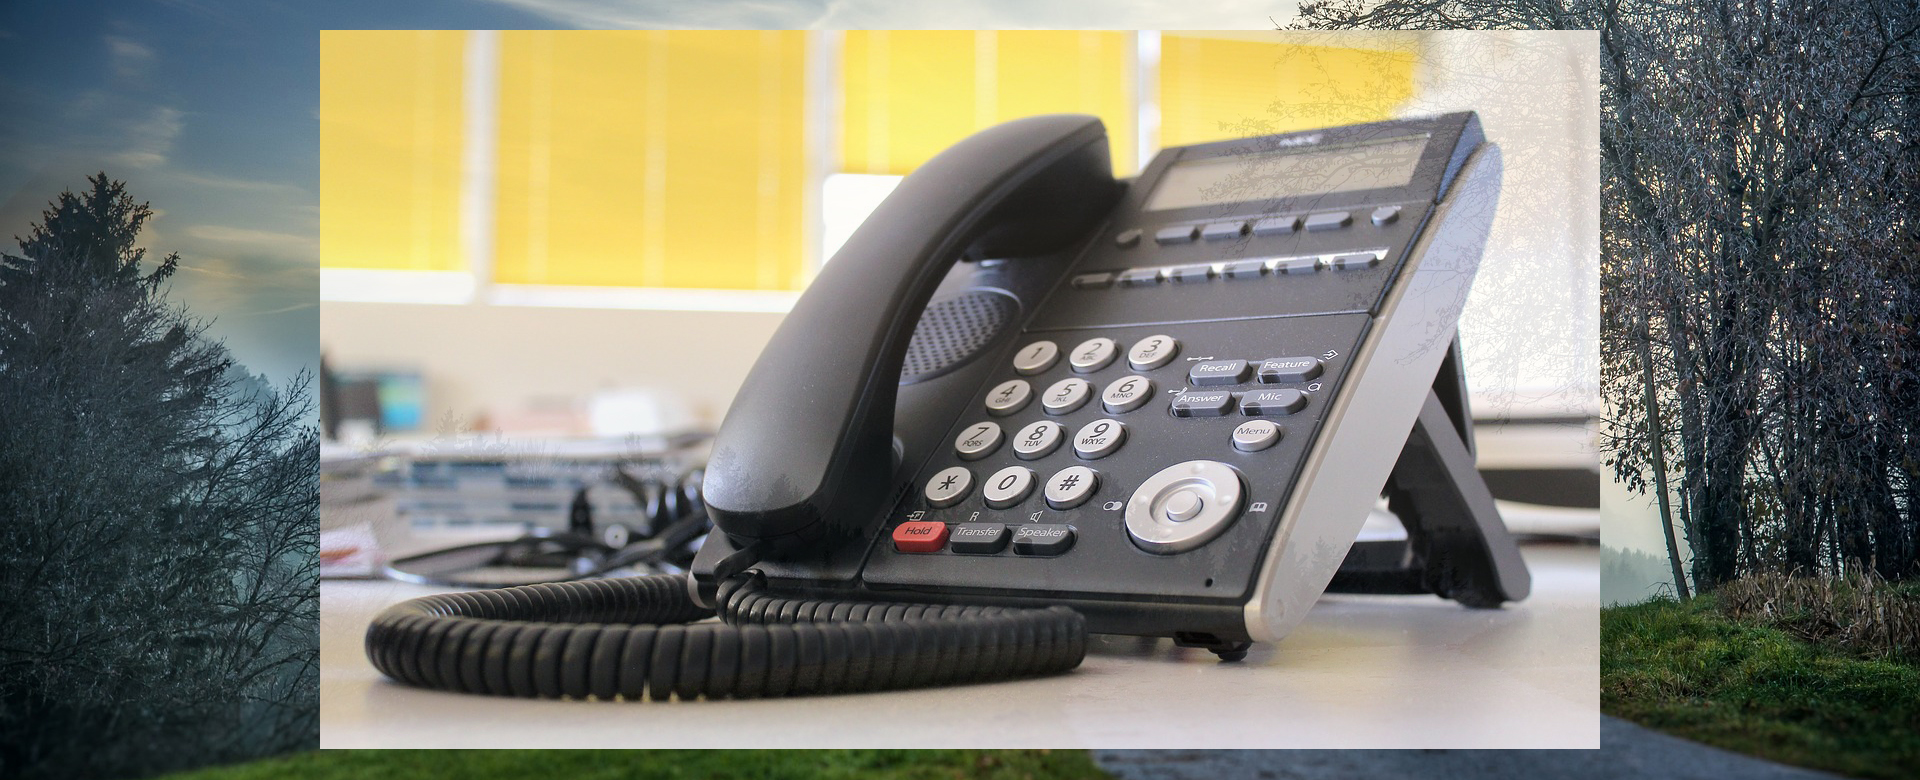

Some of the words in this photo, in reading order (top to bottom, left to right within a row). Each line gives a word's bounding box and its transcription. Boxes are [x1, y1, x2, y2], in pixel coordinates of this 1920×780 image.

[1083, 342, 1102, 355] 2
[1143, 339, 1162, 353] 3
[1030, 346, 1044, 360] 1
[1199, 363, 1237, 373] Recall
[1263, 359, 1310, 369] Feature
[1000, 384, 1018, 398] 4
[1057, 383, 1077, 397] 5
[1118, 379, 1138, 393] 6
[1177, 394, 1224, 403] Answer
[1257, 392, 1283, 401] Mic
[968, 426, 990, 441] 7
[1028, 425, 1048, 440] 8
[1089, 422, 1110, 438] 9
[1236, 427, 1271, 435] Menu
[962, 439, 984, 447] PQRS
[1081, 438, 1107, 446] WXYZ
[997, 474, 1018, 491] 0
[1059, 474, 1080, 491] #
[969, 511, 980, 521] R
[904, 527, 933, 535] Hold
[957, 526, 1001, 536] Transfer
[1017, 526, 1066, 538] Speaker
